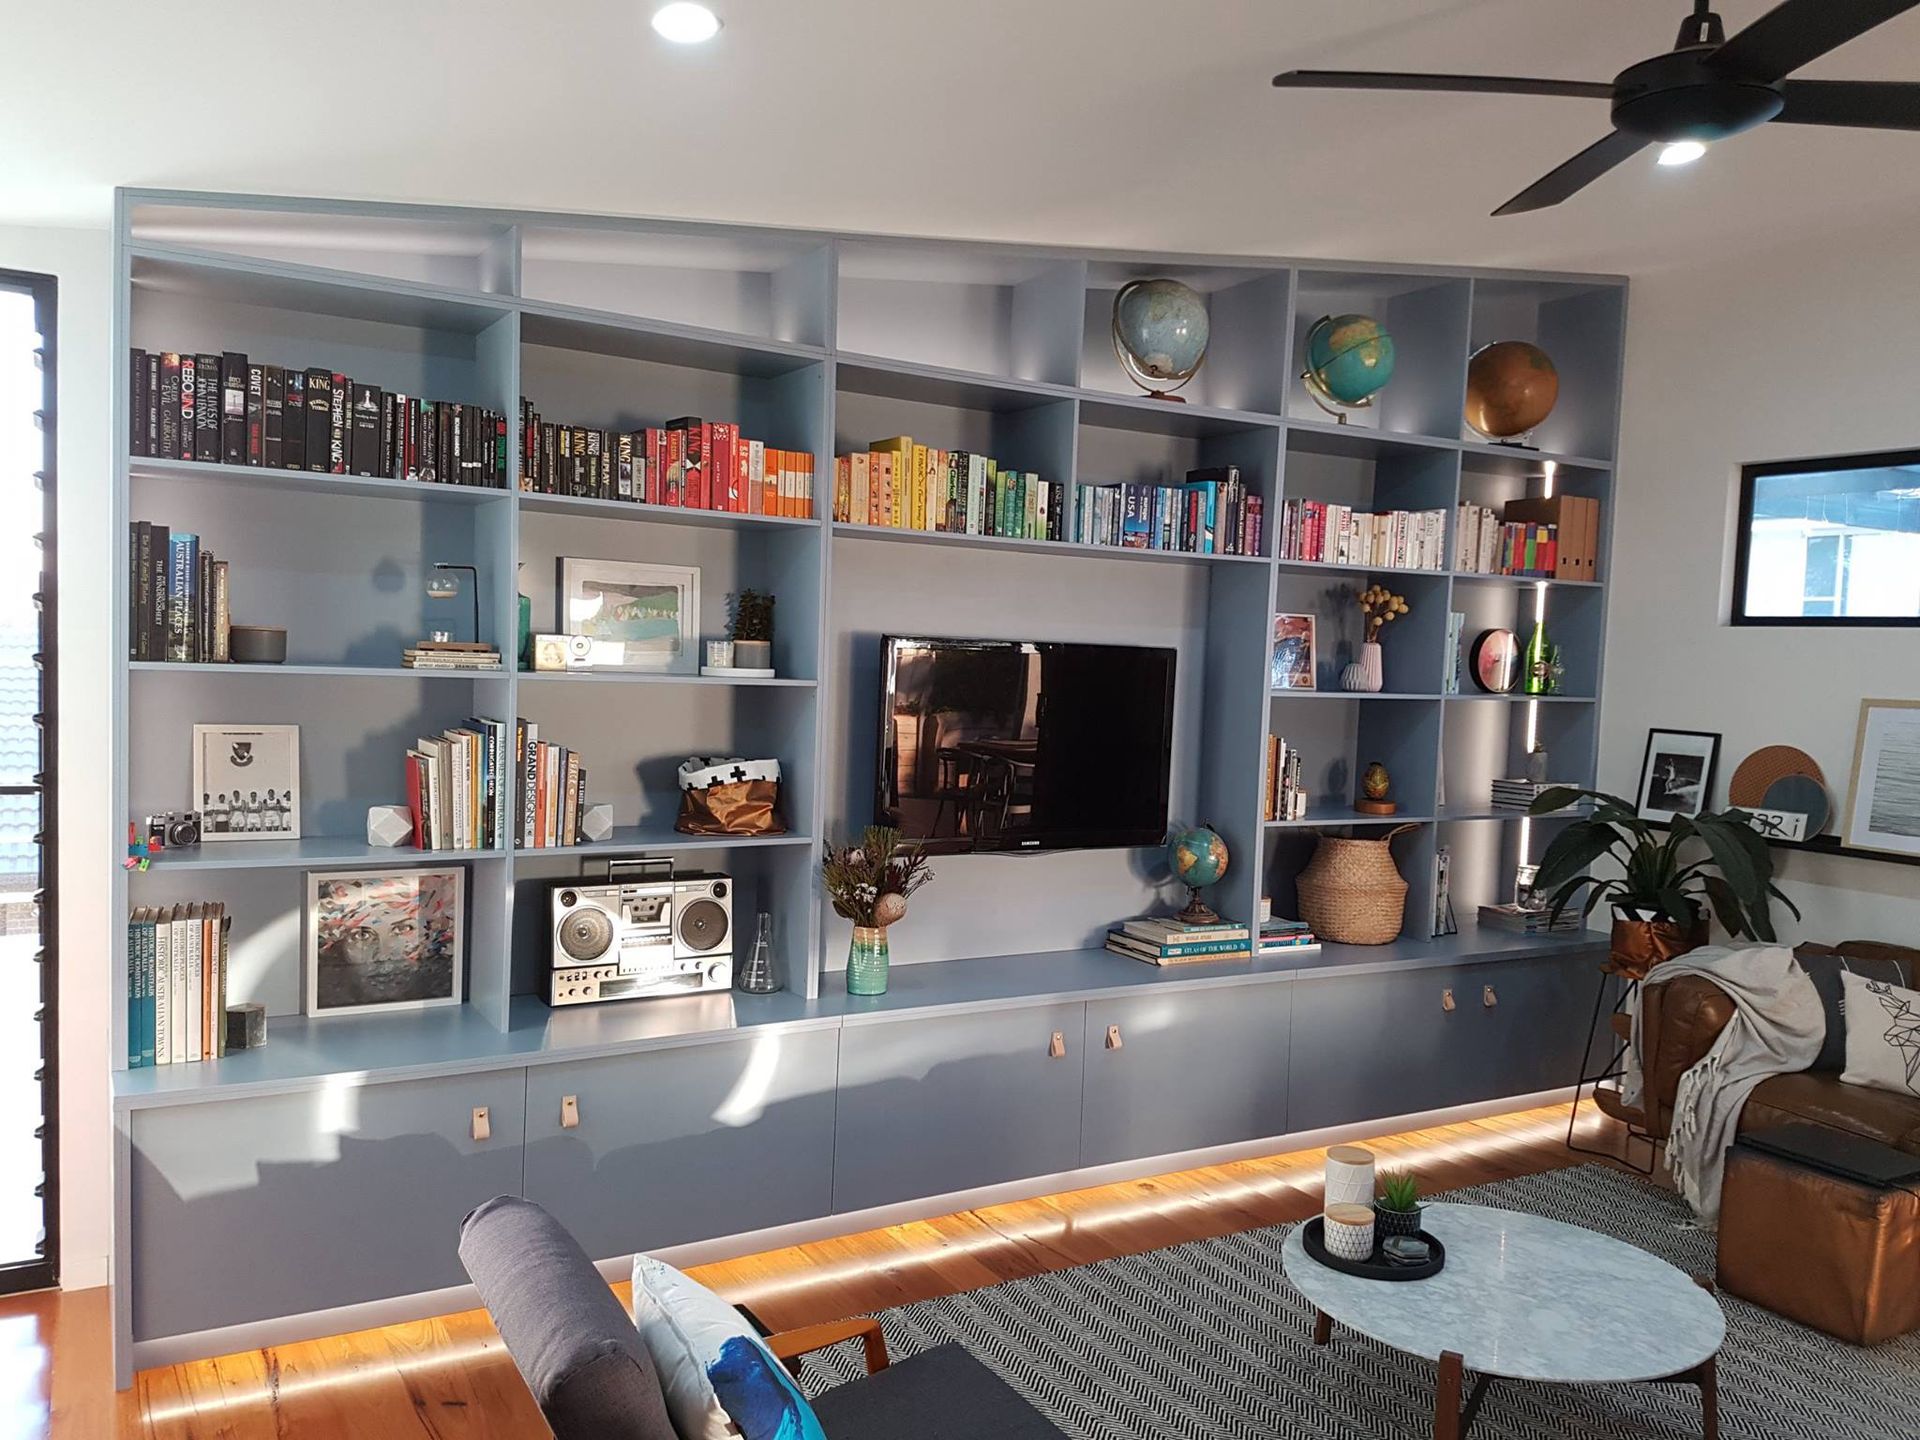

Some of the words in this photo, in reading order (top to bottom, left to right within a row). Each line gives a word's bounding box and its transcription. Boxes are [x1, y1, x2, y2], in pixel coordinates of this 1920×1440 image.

[161, 385, 171, 405] EVIL
[181, 360, 195, 419] REBOUND
[197, 377, 207, 397] JOHN
[207, 378, 218, 393] THE
[250, 368, 262, 396] COVET
[309, 377, 331, 391] KING
[197, 399, 207, 430] LENNON
[207, 396, 218, 418] LIVES
[332, 388, 344, 428] STEPHEN
[207, 419, 218, 430] OF
[331, 440, 343, 463] KING
[574, 433, 586, 456] KING
[587, 432, 597, 455] KING
[619, 437, 631, 463] KING
[688, 427, 701, 454] KING
[602, 452, 610, 485] REPLAY
[949, 469, 957, 501] Clarkso
[1127, 496, 1136, 518] USA
[155, 559, 163, 573] THE
[175, 541, 184, 598] AUSTRALIAN
[174, 600, 184, 634] PLACES
[498, 736, 506, 776] TREASURES
[527, 741, 537, 780] GRAND
[568, 759, 579, 784] SHACK
[497, 790, 505, 830] AUSTRALIA
[526, 781, 536, 824] DESIGNS
[157, 937, 166, 974] HISTORIC
[157, 976, 167, 1026] AUSTRALIAN
[157, 1028, 165, 1058] TOWNS
